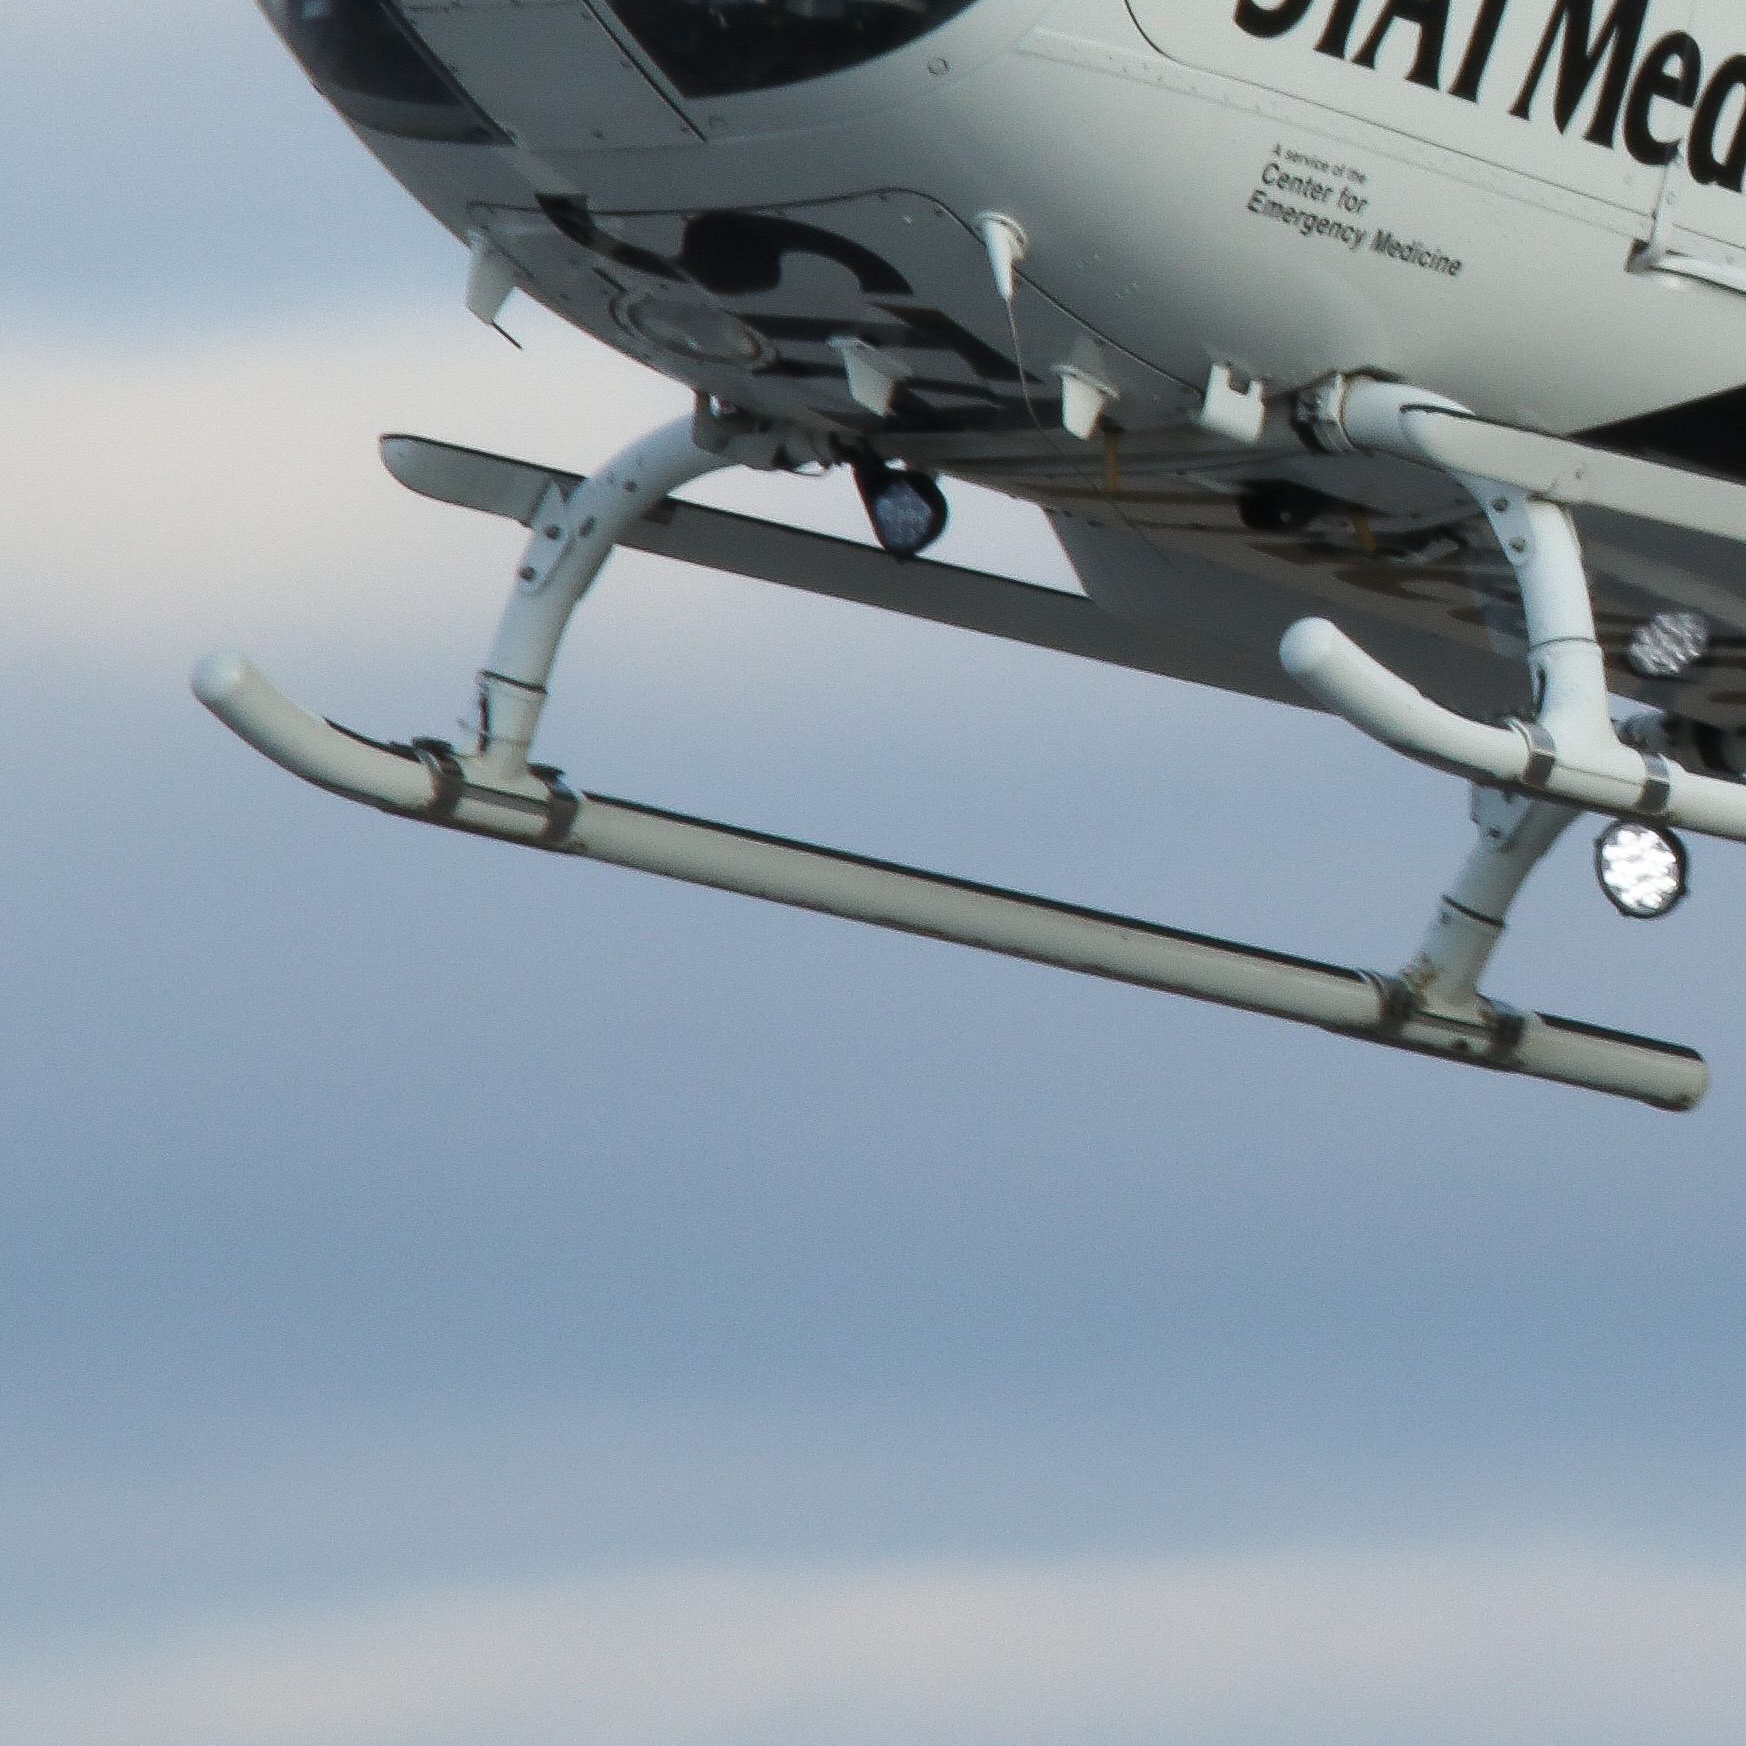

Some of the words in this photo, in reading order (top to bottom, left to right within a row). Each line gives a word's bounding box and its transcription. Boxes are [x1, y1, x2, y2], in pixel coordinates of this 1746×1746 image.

[1261, 162, 1334, 203] Center
[1337, 185, 1370, 215] for
[1284, 149, 1330, 174] service
[1346, 168, 1368, 185] the
[1245, 189, 1368, 253] Emergency
[1370, 228, 1464, 278] Medicine
